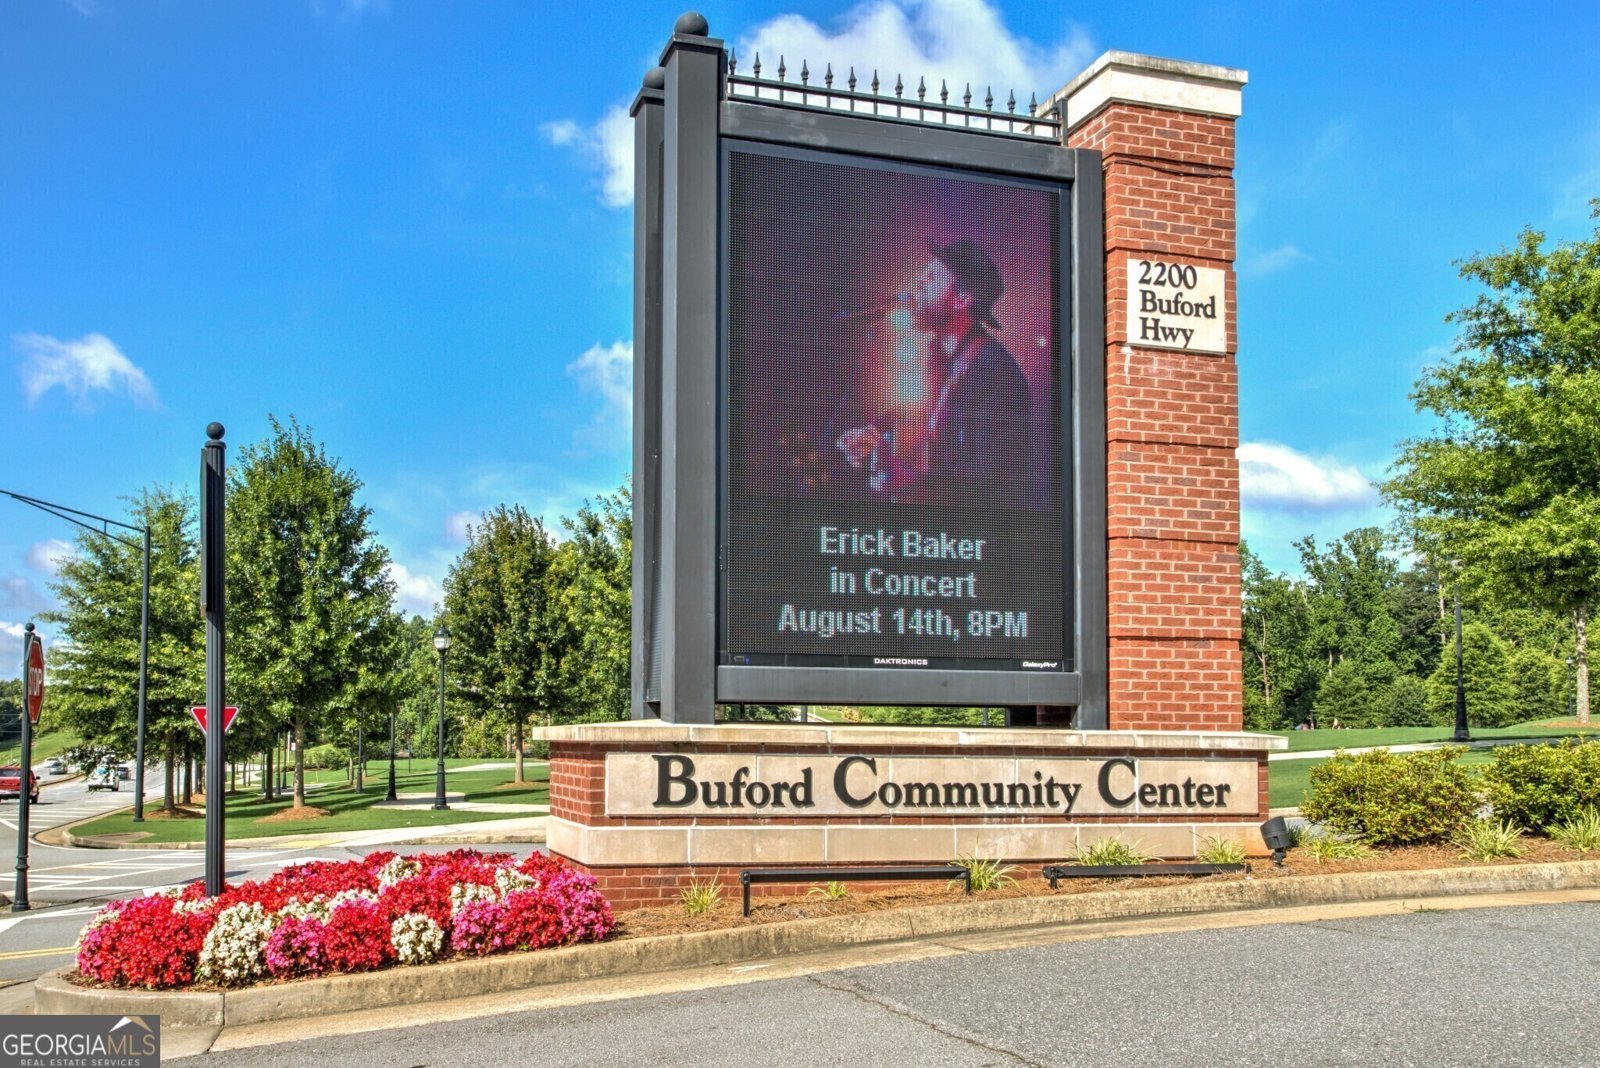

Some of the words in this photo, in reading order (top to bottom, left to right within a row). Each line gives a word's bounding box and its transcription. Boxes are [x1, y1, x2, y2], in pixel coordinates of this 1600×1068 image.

[1138, 260, 1197, 289] 2200
[1139, 289, 1216, 318] Buford
[1139, 317, 1194, 348] Hwy
[819, 526, 896, 556] Erick
[902, 530, 986, 560] Baker
[829, 566, 856, 594] in
[864, 567, 977, 598] Concert
[778, 603, 882, 638] August
[892, 607, 960, 641] 14th,
[967, 610, 1029, 638] 8PM
[873, 657, 928, 666] DAKTRONICS
[652, 754, 814, 808] Buford
[832, 756, 1082, 813] Community
[1097, 758, 1232, 808] Center
